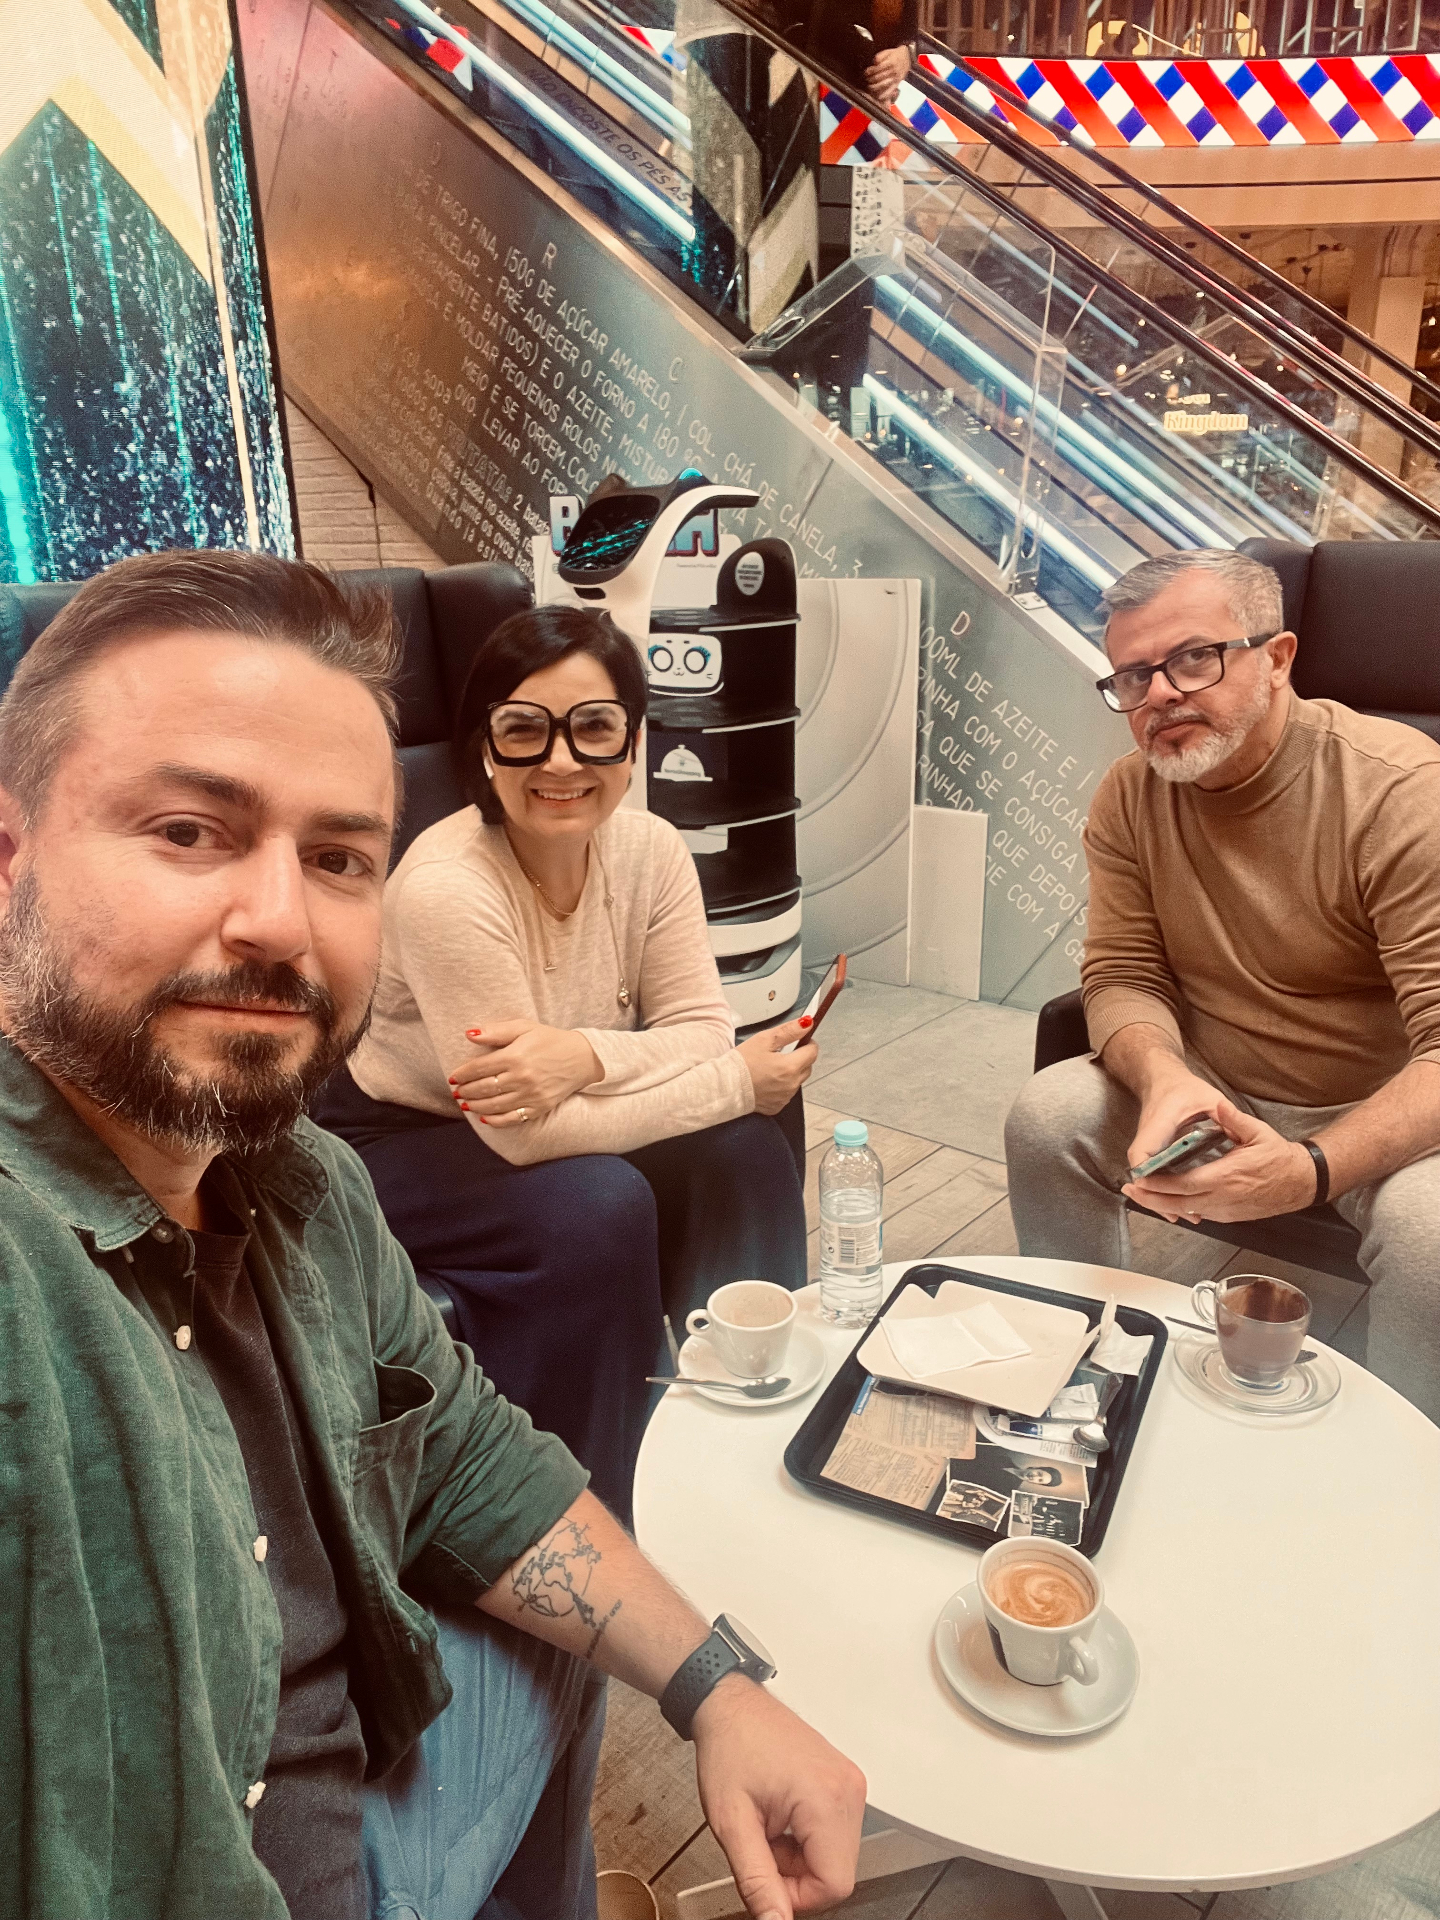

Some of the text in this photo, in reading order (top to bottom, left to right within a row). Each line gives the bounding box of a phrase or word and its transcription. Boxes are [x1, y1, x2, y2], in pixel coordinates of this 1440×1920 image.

[617, 143, 641, 161] OS
[443, 301, 453, 322] E
[455, 312, 500, 366] MOLDAR
[500, 356, 560, 423] PEQUENOS
[561, 416, 601, 462] ROLOS
[454, 383, 477, 418] OVO.
[482, 407, 521, 458] LEVAR
[521, 452, 541, 475] AO
[461, 355, 489, 391] MEIO
[490, 384, 502, 404] E
[502, 395, 520, 422] SE
[469, 217, 499, 261] FINA,
[503, 246, 536, 288] 150G
[536, 279, 557, 307] DE
[557, 299, 609, 356] AÇÚCAR
[609, 348, 670, 419] AMARELO,
[689, 419, 716, 458] COL.
[724, 452, 756, 489] CHÁ
[757, 481, 778, 511] DE
[780, 503, 838, 572] CANELA,
[482, 303, 540, 367] BATIDOS)
[540, 358, 552, 379] E
[554, 371, 565, 390] O
[566, 385, 614, 443] AZEITE,
[496, 275, 580, 367] PRÉ-AQUECER
[581, 359, 592, 378] O
[593, 370, 636, 418] FORNO
[637, 413, 649, 433] A
[653, 422, 679, 459] 180
[1164, 409, 1248, 436] Kingdom
[513, 493, 524, 512] 2
[541, 242, 557, 270] R
[668, 356, 683, 382] C
[950, 610, 970, 636] D
[481, 519, 494, 538] os
[493, 531, 516, 560] ovos
[920, 623, 961, 680] 00ML
[964, 671, 994, 704] DE
[991, 699, 1059, 762] AZEITE
[1057, 755, 1078, 779] E
[917, 754, 1089, 926] RINHAD QUE DEPOIS
[938, 736, 976, 776] QUE
[975, 770, 1004, 801] SE
[1004, 797, 1078, 875] CONSIGA
[964, 715, 1003, 755] COM
[1002, 751, 1019, 771] O
[1018, 769, 1089, 839] AÇÚCAR
[986, 855, 1007, 886] IE
[1006, 883, 1045, 923] COM
[1043, 921, 1060, 941] A
